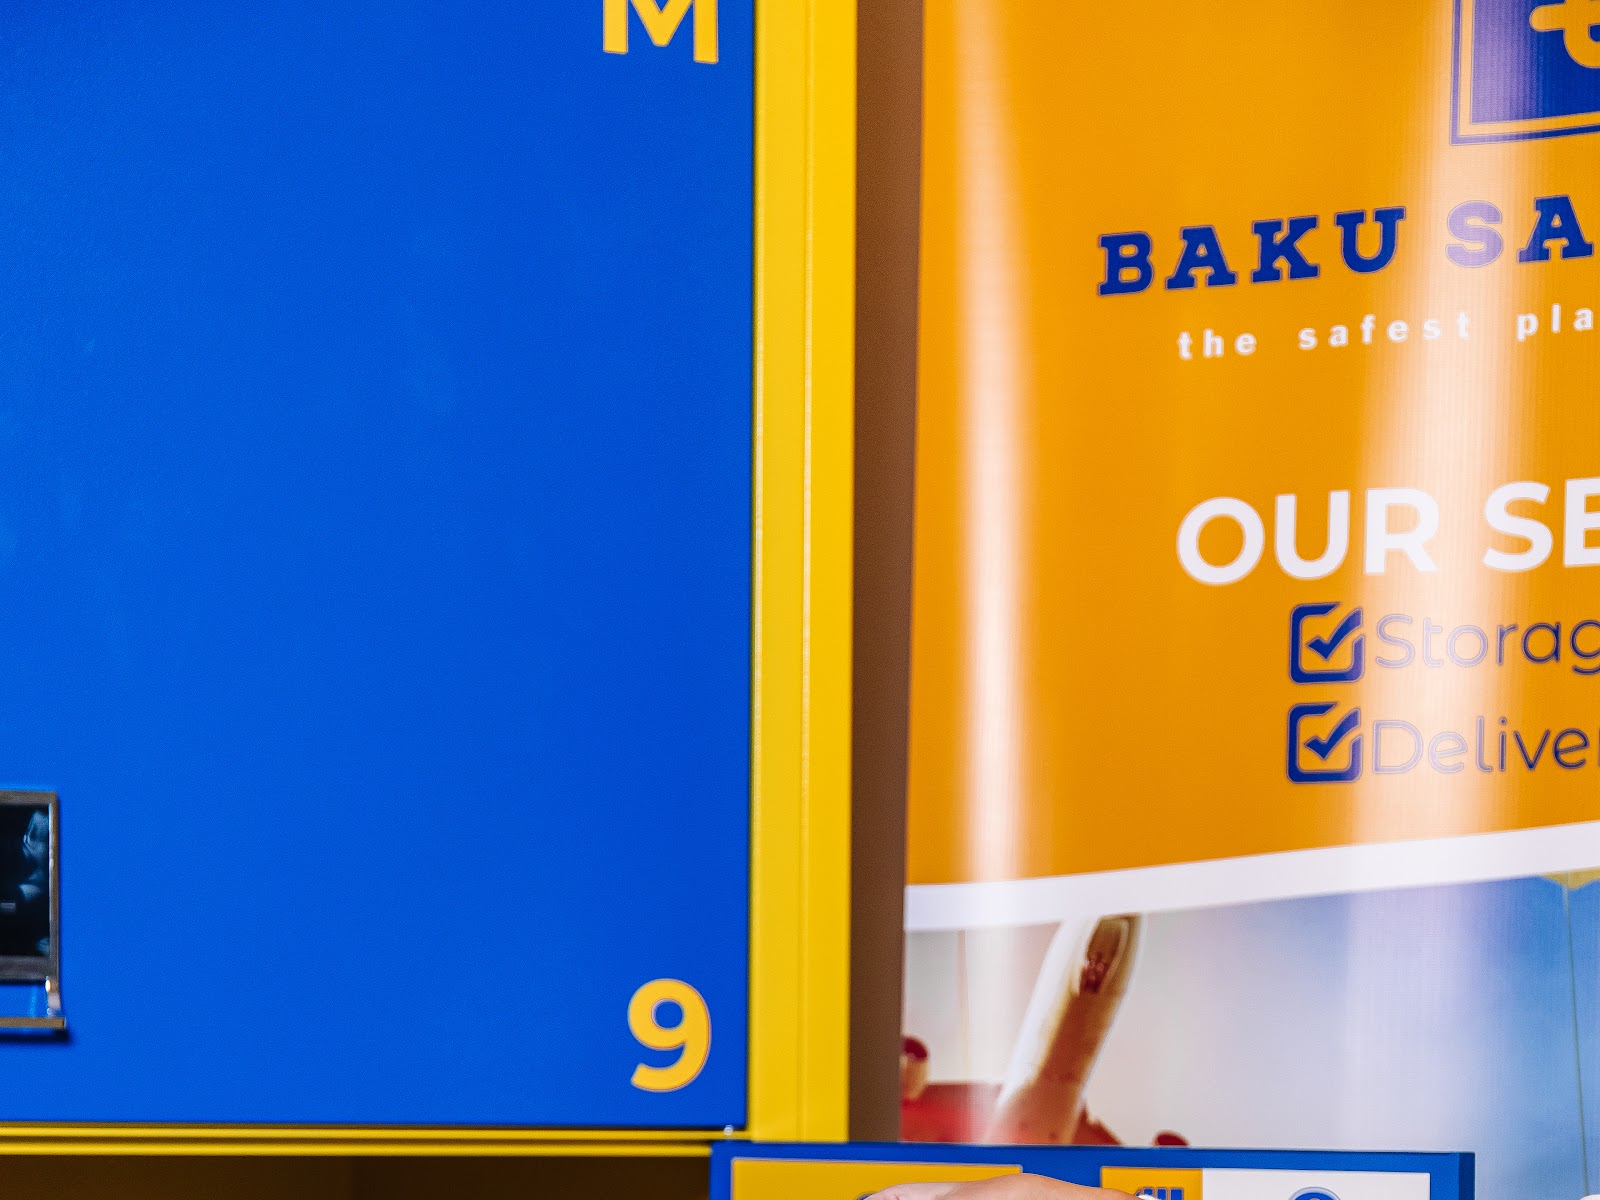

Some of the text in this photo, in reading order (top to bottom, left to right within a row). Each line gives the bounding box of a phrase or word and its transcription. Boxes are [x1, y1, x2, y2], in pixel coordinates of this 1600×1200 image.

[602, 0, 719, 64] M
[1097, 194, 1595, 297] BAKU SA
[1176, 302, 1594, 361] the safest pla
[1176, 486, 1440, 586] OUR
[1372, 715, 1600, 775] Delive
[627, 978, 712, 1094] 9
